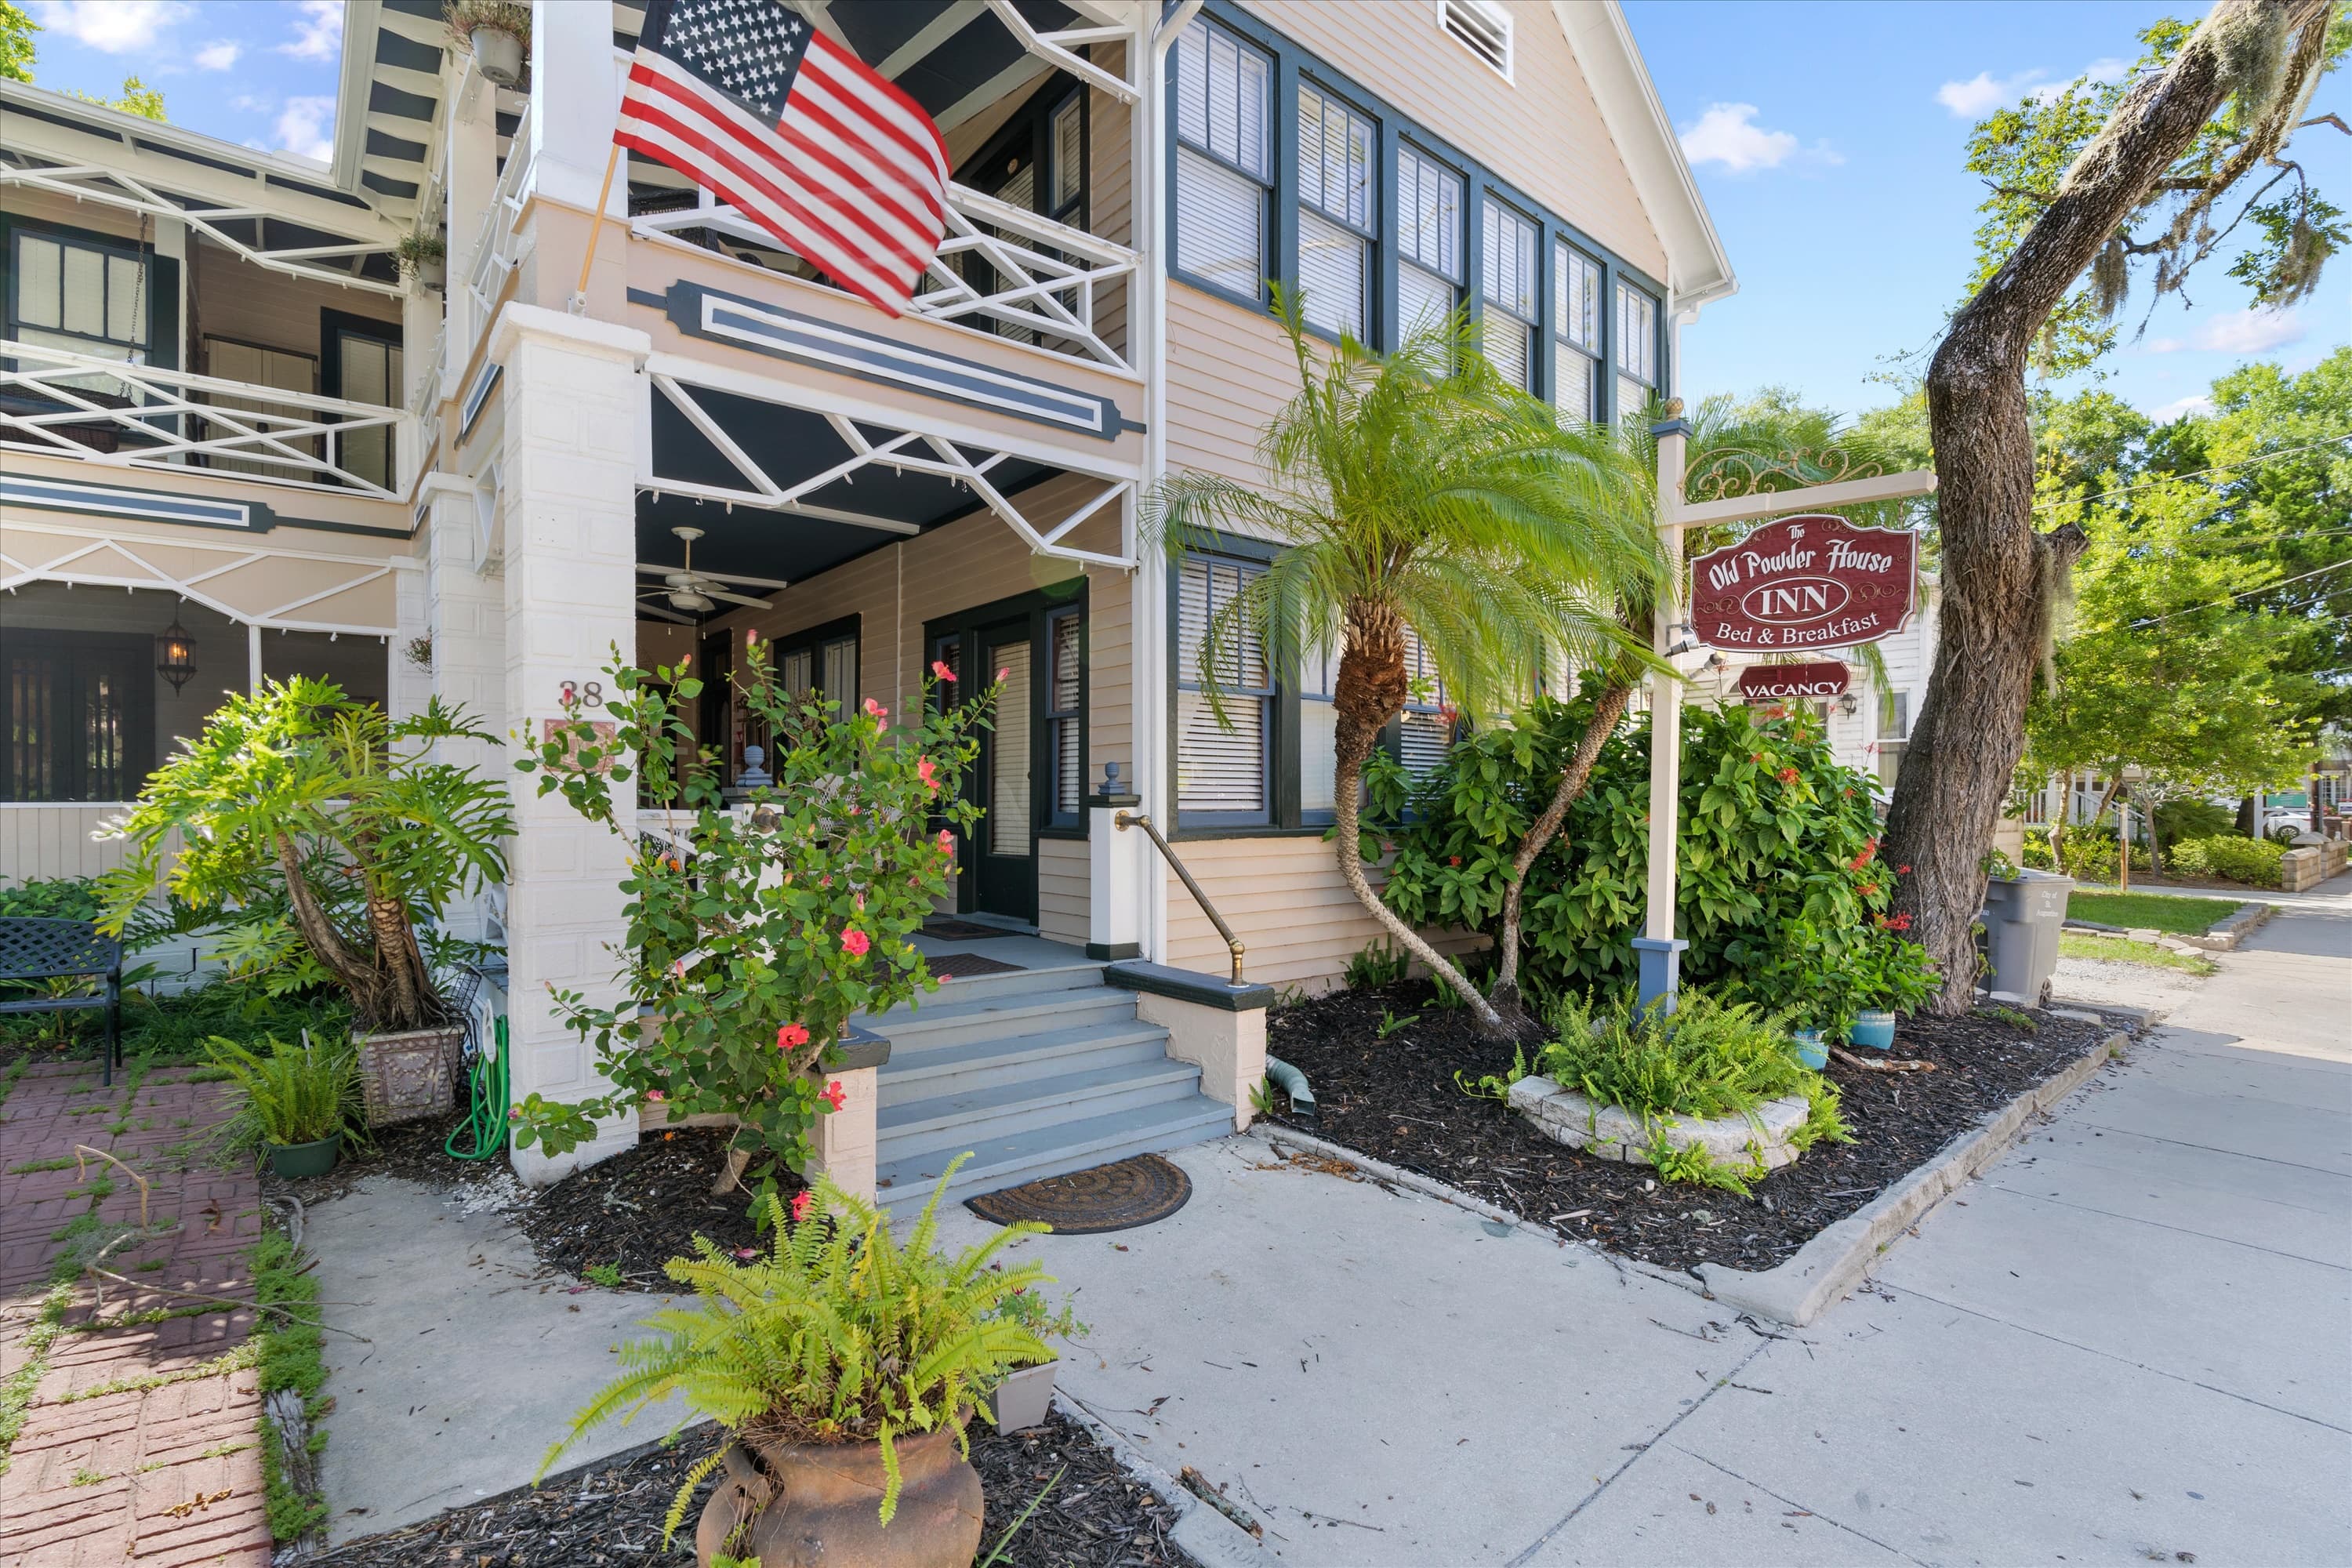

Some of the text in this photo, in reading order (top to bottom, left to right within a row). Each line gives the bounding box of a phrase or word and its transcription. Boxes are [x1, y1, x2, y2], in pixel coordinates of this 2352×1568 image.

[1786, 523, 1806, 539] The
[1708, 539, 1893, 591] Old Powder House
[1759, 584, 1831, 615] INN
[1715, 612, 1880, 644] Bed & Breakfast
[558, 680, 603, 707] 38
[1745, 681, 1842, 697] VACANCY
